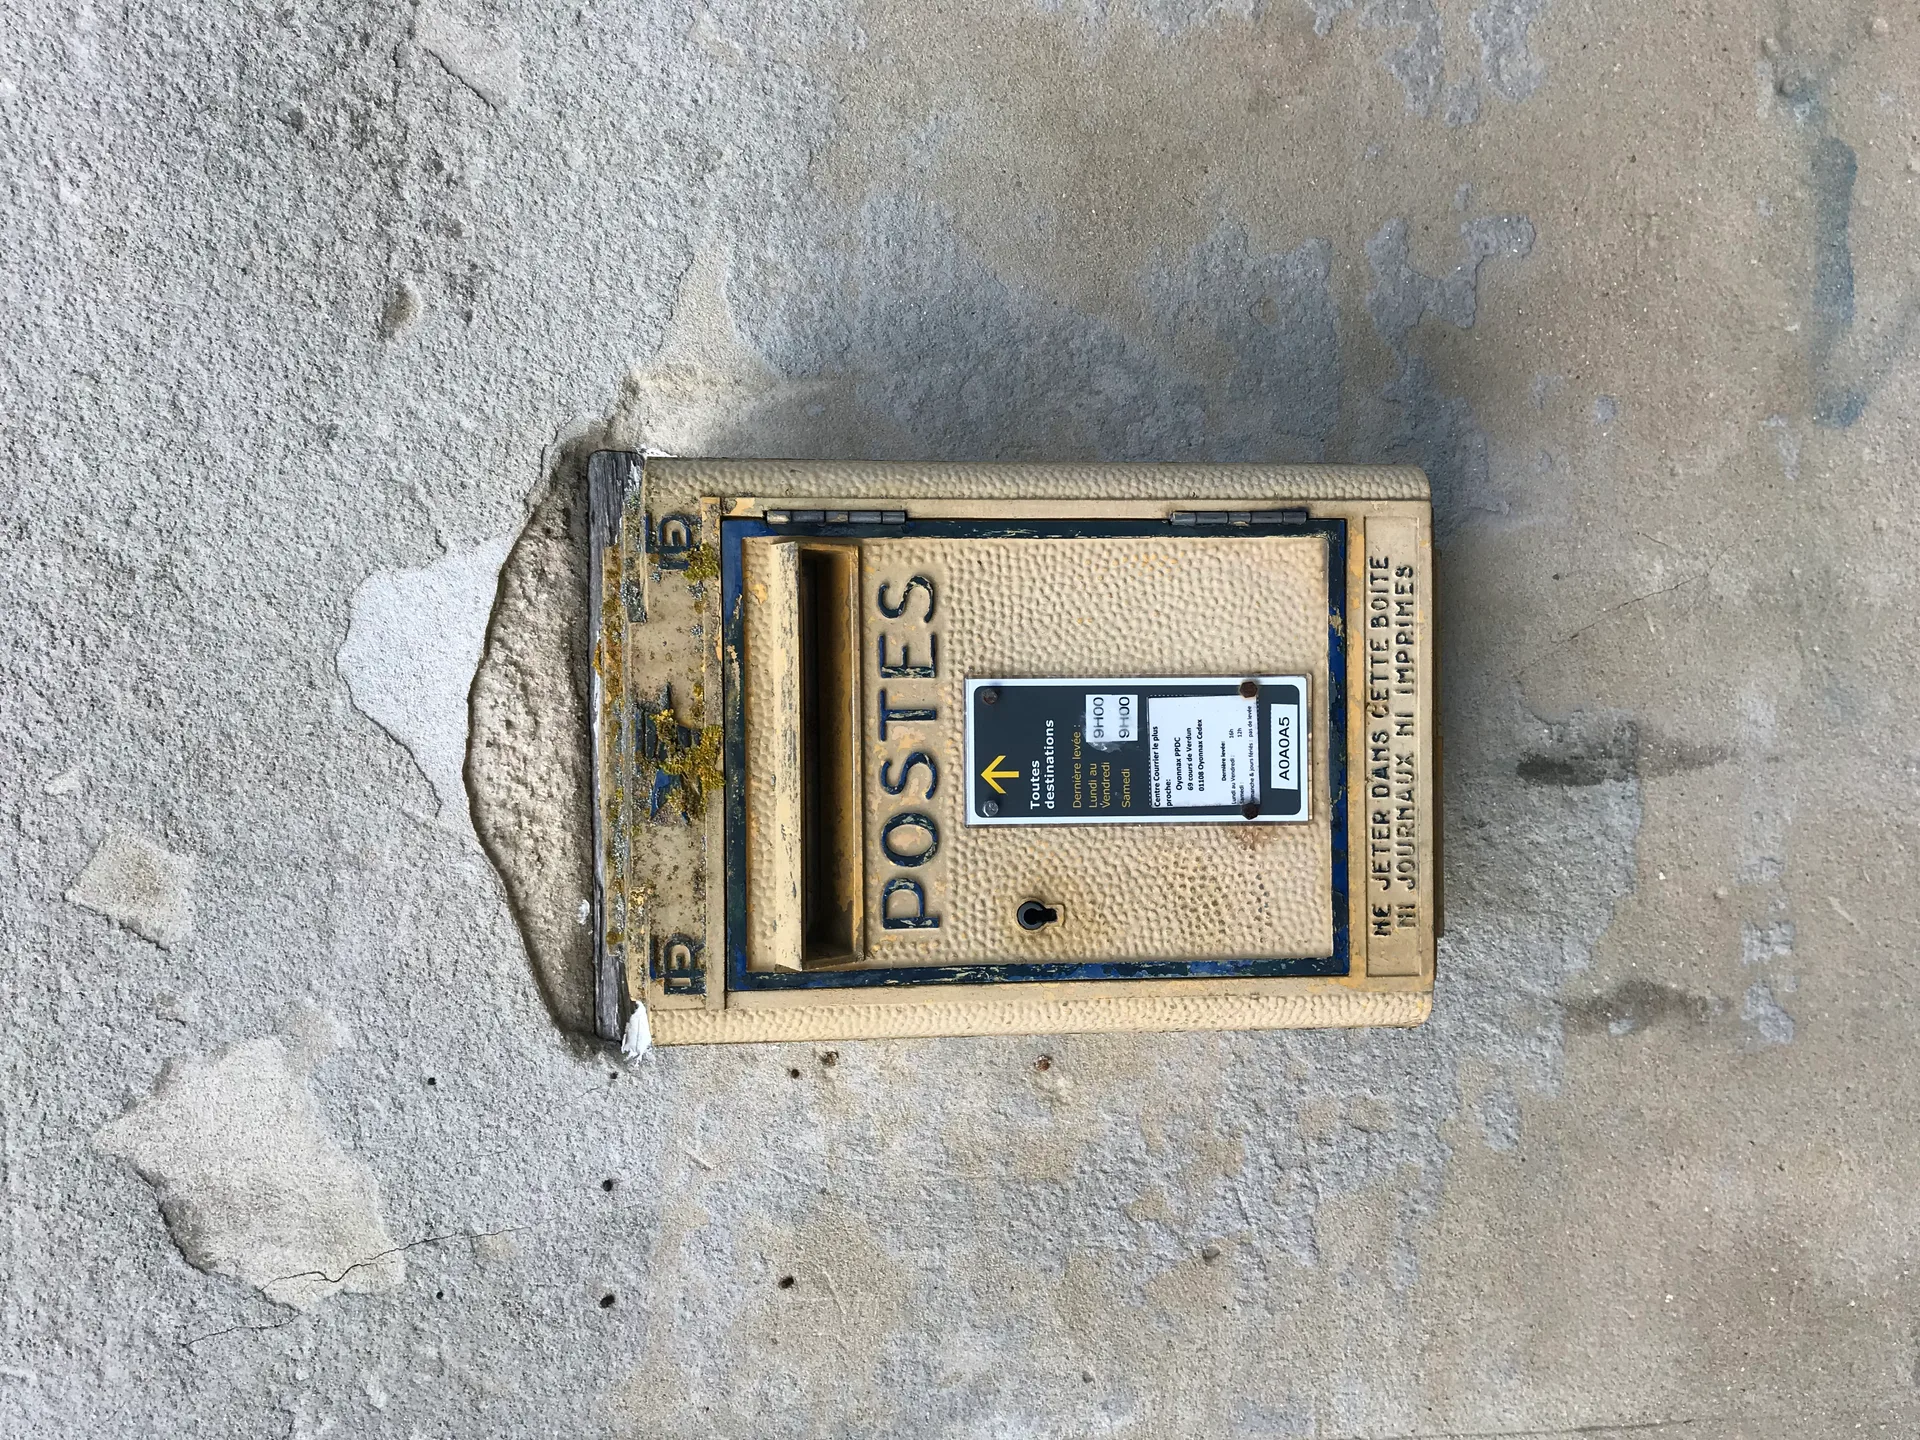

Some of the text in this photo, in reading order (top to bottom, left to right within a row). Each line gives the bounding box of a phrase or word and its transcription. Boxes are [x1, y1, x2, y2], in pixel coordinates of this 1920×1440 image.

[1093, 697, 1104, 738] 9H00
[1118, 696, 1130, 738] 9H00
[1151, 726, 1161, 741] plus
[878, 576, 940, 930] POSTES
[1044, 720, 1054, 809] destinations
[1071, 732, 1081, 760] levée
[1186, 754, 1192, 762] de
[1197, 741, 1205, 770] Oyonnax
[1369, 556, 1391, 937] NE JETER DANS CETTE BOITE
[1394, 565, 1416, 928] NI JOURNAUX NI IMPRIMES
[1030, 760, 1040, 810] Toutes
[1072, 762, 1082, 808] Dernière
[1088, 764, 1098, 808] Lundi au
[1100, 762, 1110, 808] Vendredi
[1122, 768, 1130, 808] Samedi
[1164, 779, 1173, 806] proche:
[1176, 758, 1184, 790] Oyonnax
[1187, 782, 1194, 790] 69
